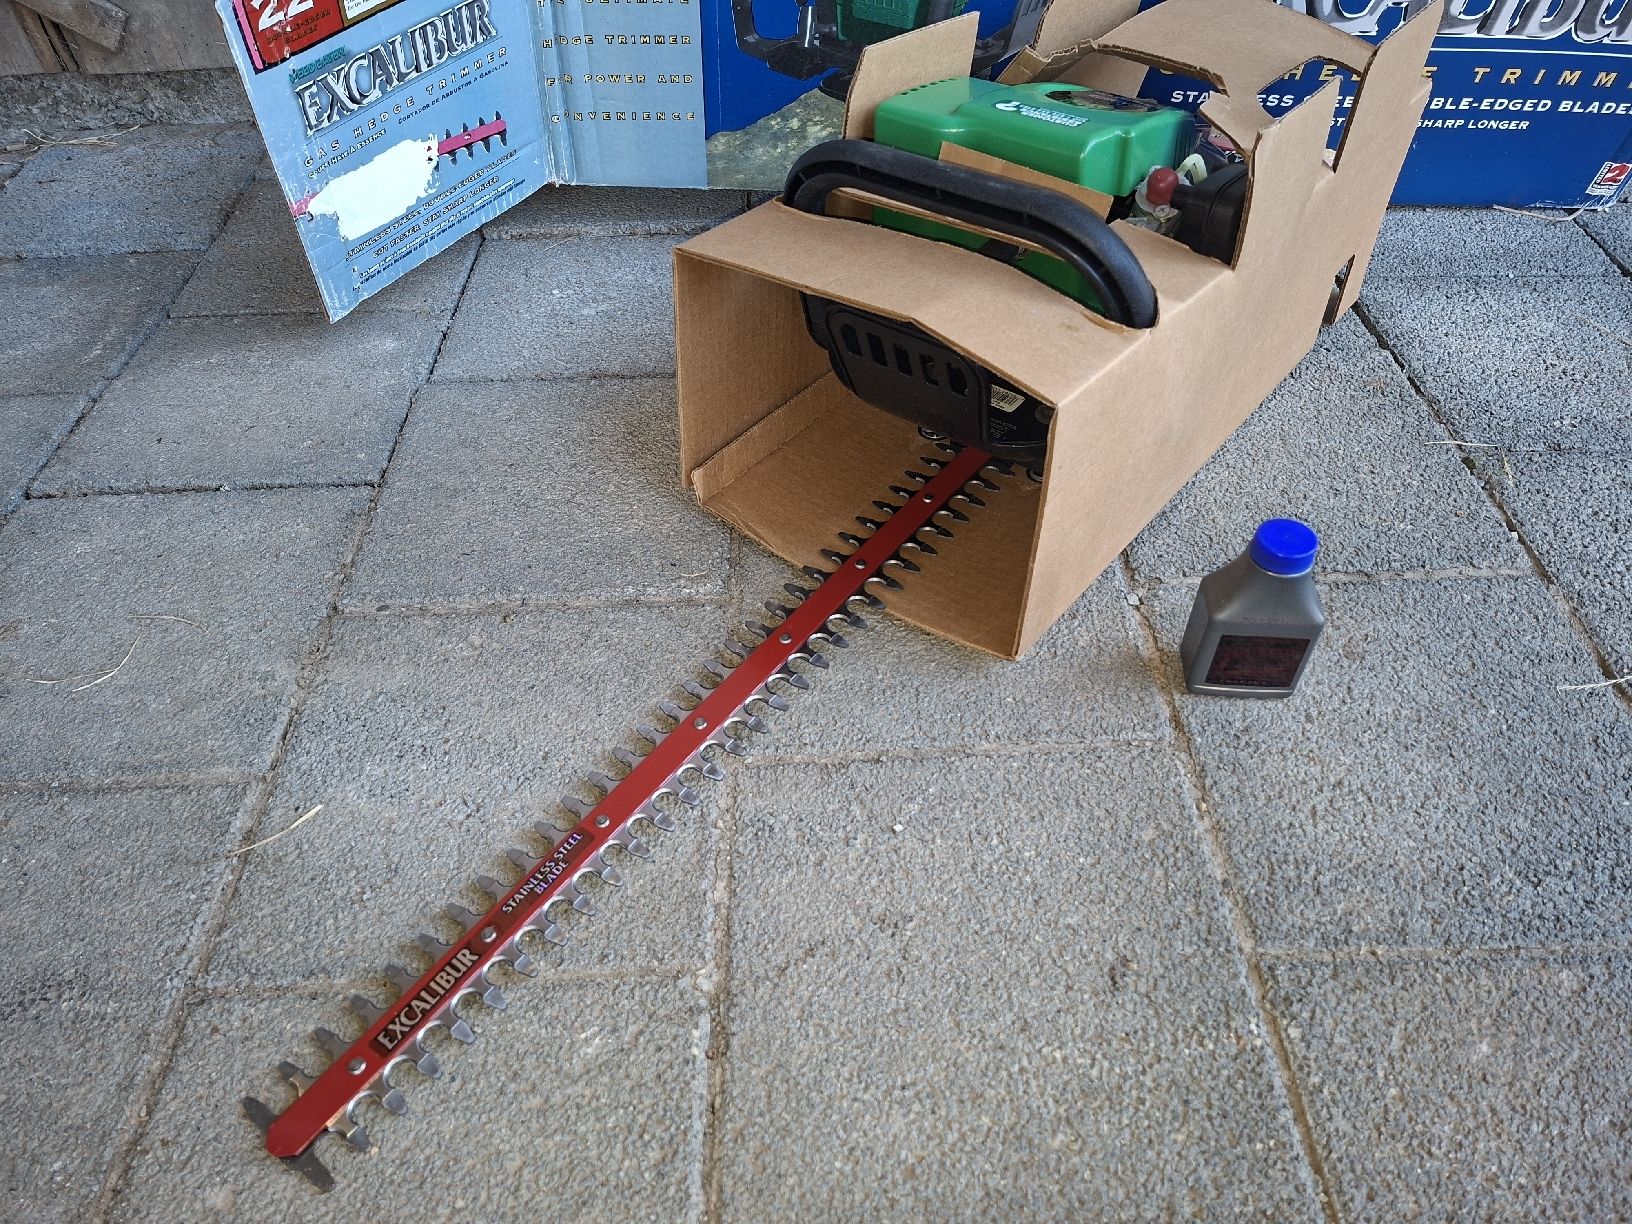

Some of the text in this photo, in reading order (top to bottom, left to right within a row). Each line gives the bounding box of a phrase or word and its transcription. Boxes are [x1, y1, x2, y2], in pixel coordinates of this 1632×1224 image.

[267, 8, 332, 44] DOLE-EDGED
[605, 35, 691, 45] TRIMMER
[294, 0, 499, 138] EXCALIBUR
[547, 74, 693, 86] FR POWER AND
[1473, 67, 1632, 89] TRIMM
[303, 47, 508, 168] GAS HEDGE TRIMMER
[1170, 90, 1295, 107] STAESS
[1424, 97, 1552, 111] BLE-EDGED
[1467, 119, 1530, 130] LONGER
[502, 831, 584, 915] STAINLESS STEEL
[534, 859, 569, 896] BLADE
[376, 947, 481, 1051] EXCALIBUR
